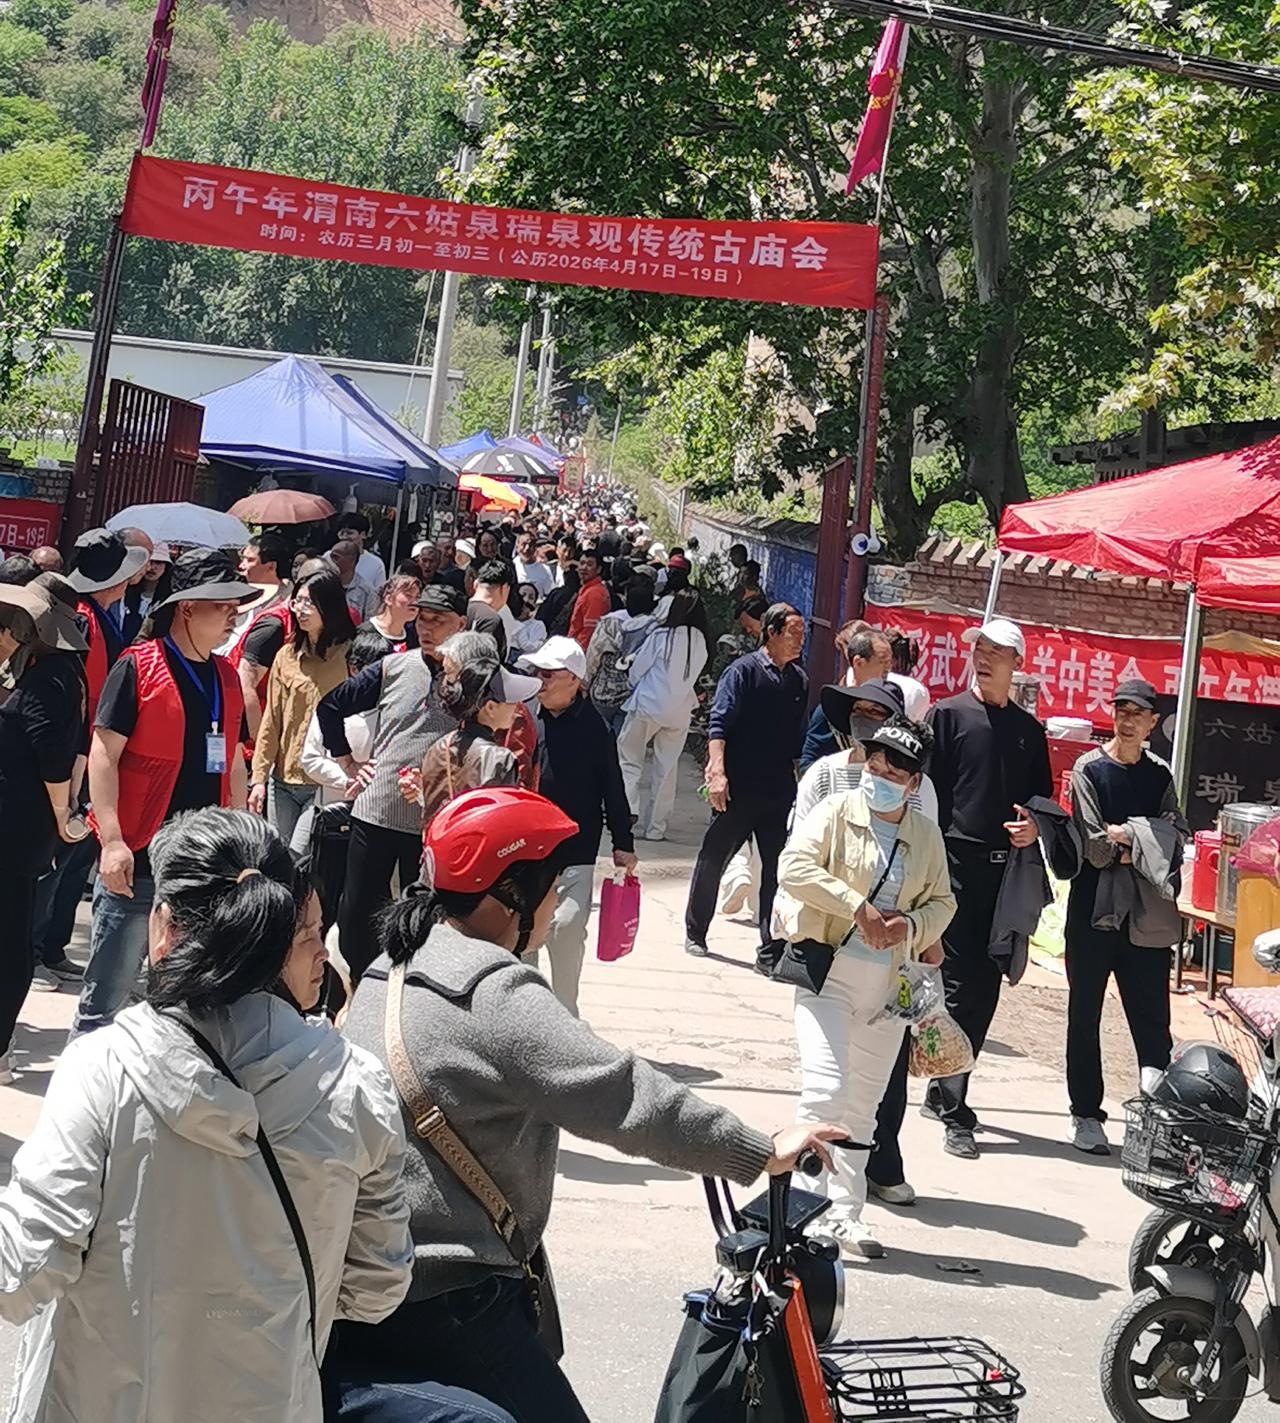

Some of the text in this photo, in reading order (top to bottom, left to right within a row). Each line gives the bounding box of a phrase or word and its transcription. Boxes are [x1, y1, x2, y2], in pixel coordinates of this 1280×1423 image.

[182, 176, 829, 271] 丙午年渭南六姑泉瑞泉观传统古庙会
[496, 838, 527, 858] COUGAR
